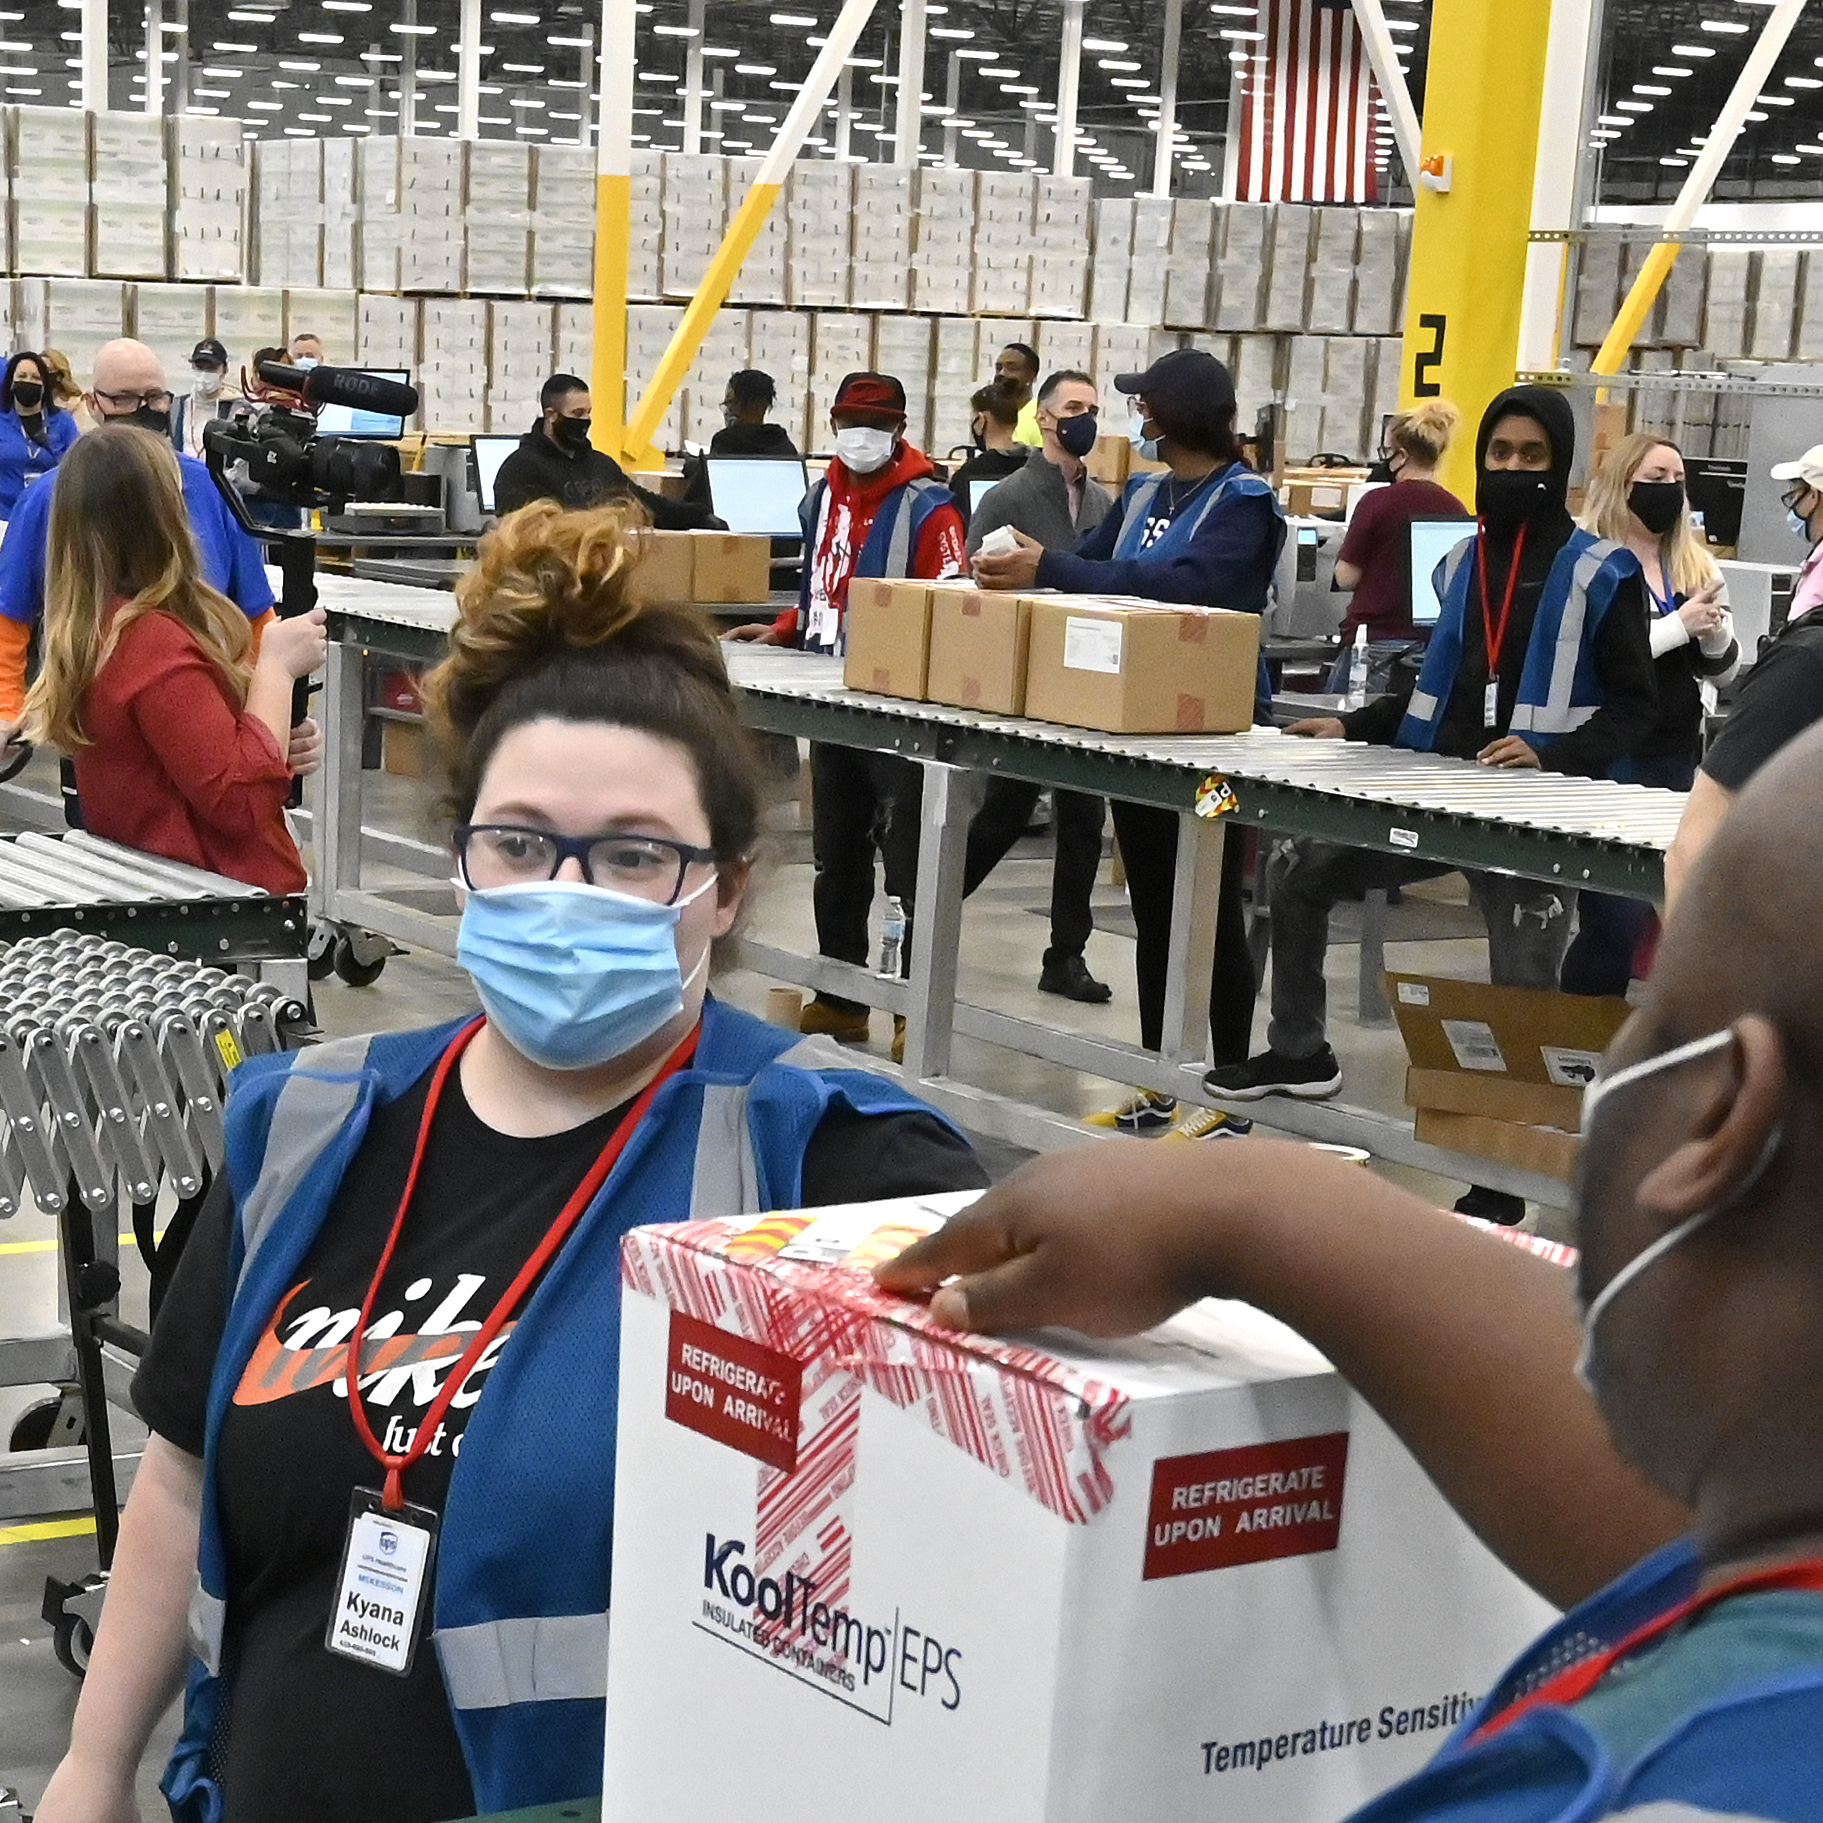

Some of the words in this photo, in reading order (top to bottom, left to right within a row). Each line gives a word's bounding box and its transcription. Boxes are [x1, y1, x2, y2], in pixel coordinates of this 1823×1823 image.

[1414, 313, 1446, 398] 2
[671, 1371, 715, 1409] UPON
[722, 1396, 794, 1442] ARRIVAL
[1171, 1465, 1326, 1510] REFRIGERATE
[1154, 1515, 1221, 1546] UPON
[1235, 1500, 1333, 1534] ARRIVAL
[346, 1590, 405, 1627] Kyana
[702, 1599, 771, 1650] INSULATED
[703, 1532, 887, 1686] KoolTemp
[900, 1625, 963, 1710] EPS
[340, 1619, 400, 1652] Ashlock
[1201, 1715, 1371, 1774] Temperature
